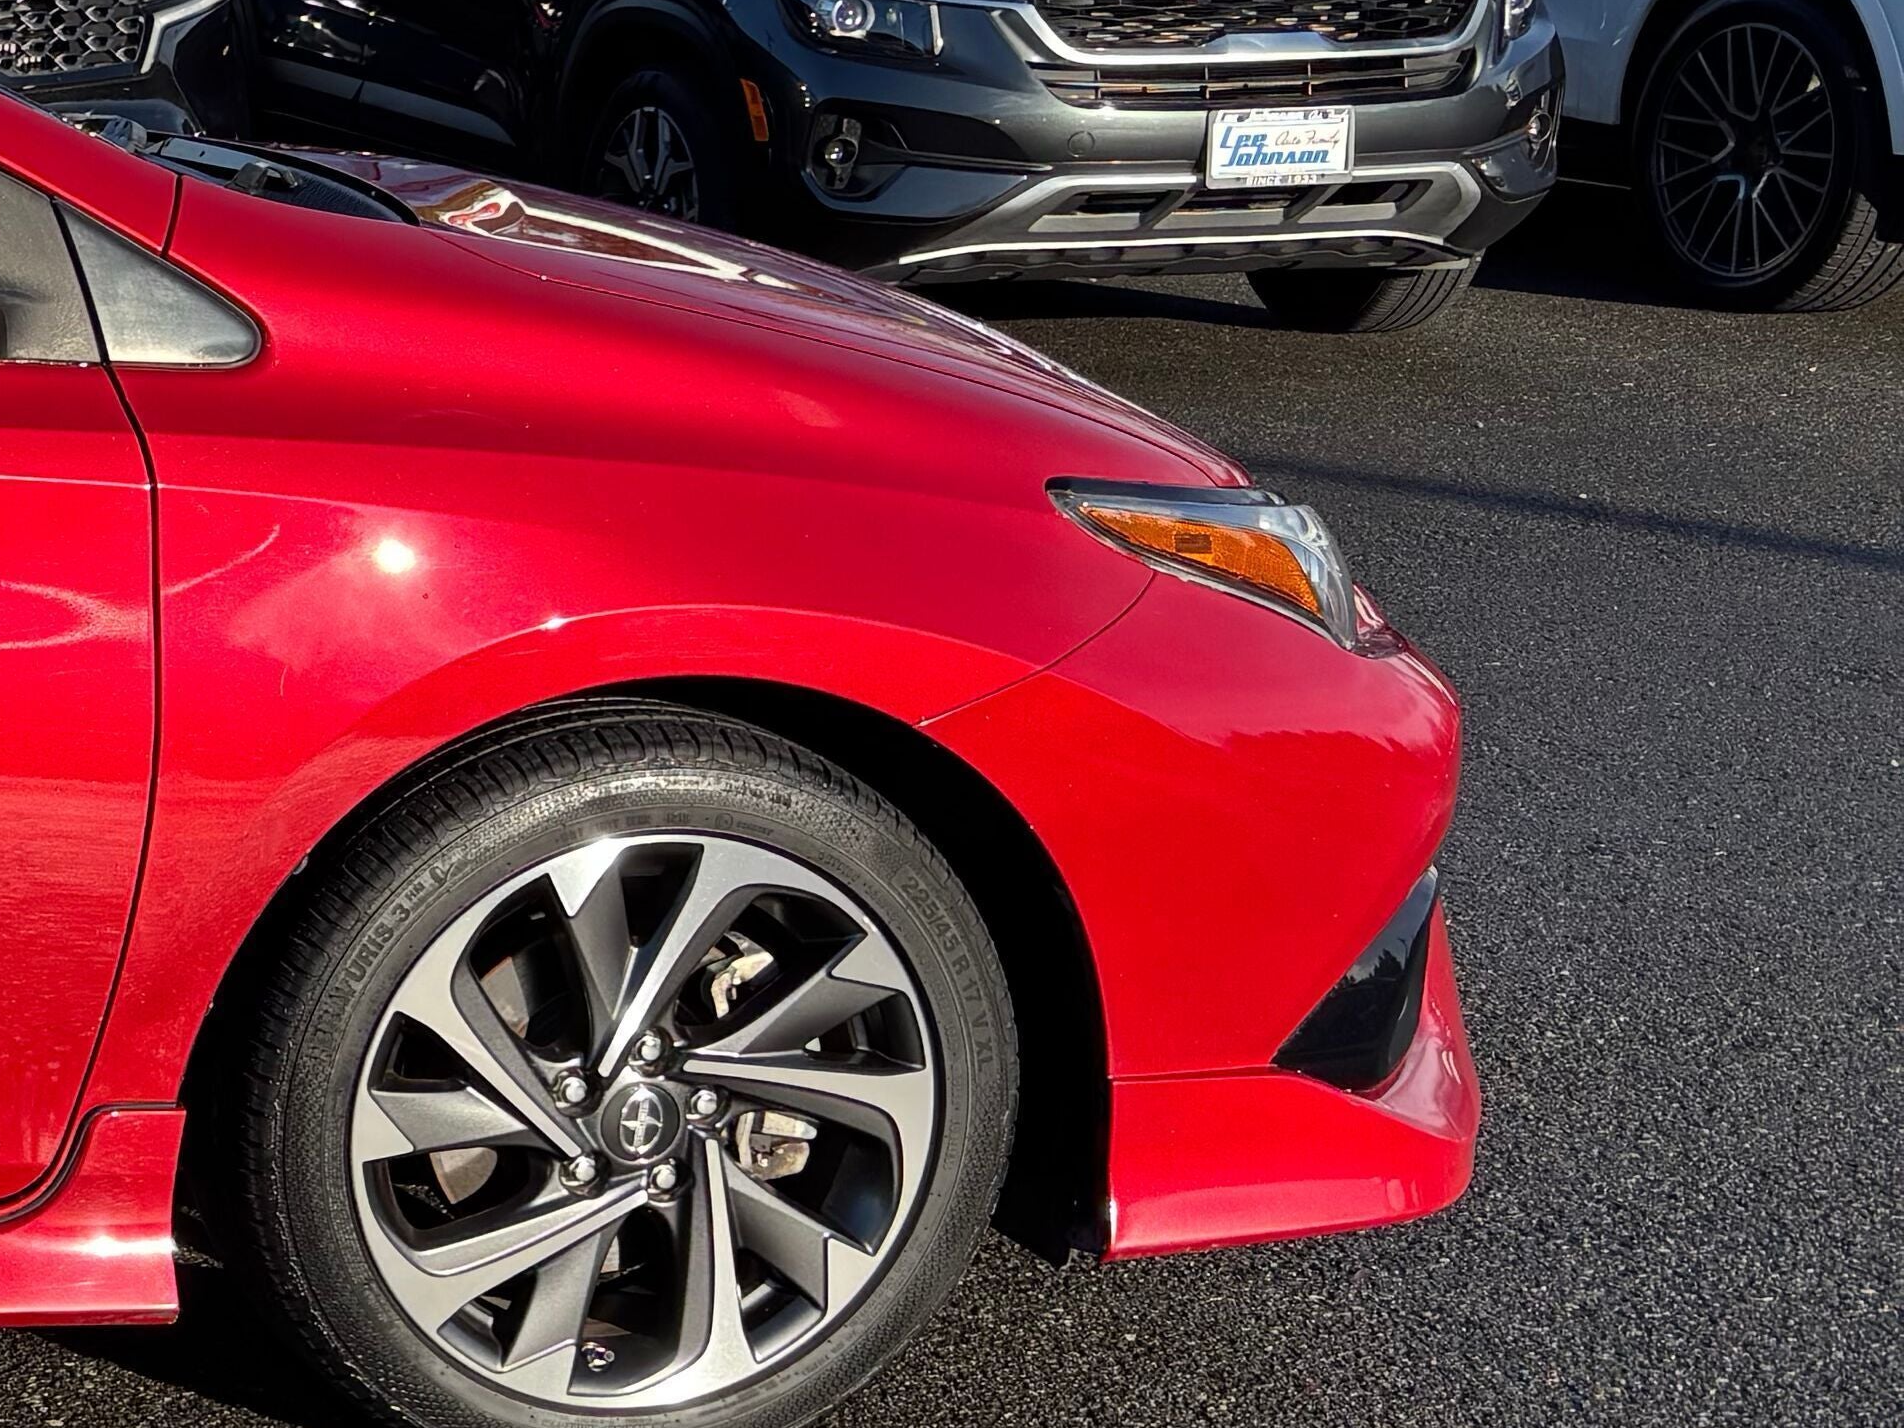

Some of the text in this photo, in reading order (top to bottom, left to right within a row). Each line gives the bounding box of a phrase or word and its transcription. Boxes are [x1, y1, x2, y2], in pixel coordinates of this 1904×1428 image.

[1220, 126, 1268, 149] Lee
[1220, 142, 1331, 167] Johnson
[900, 875, 961, 954] 225/45
[951, 953, 971, 971] R
[961, 977, 982, 1002] 17
[972, 1009, 989, 1028] V
